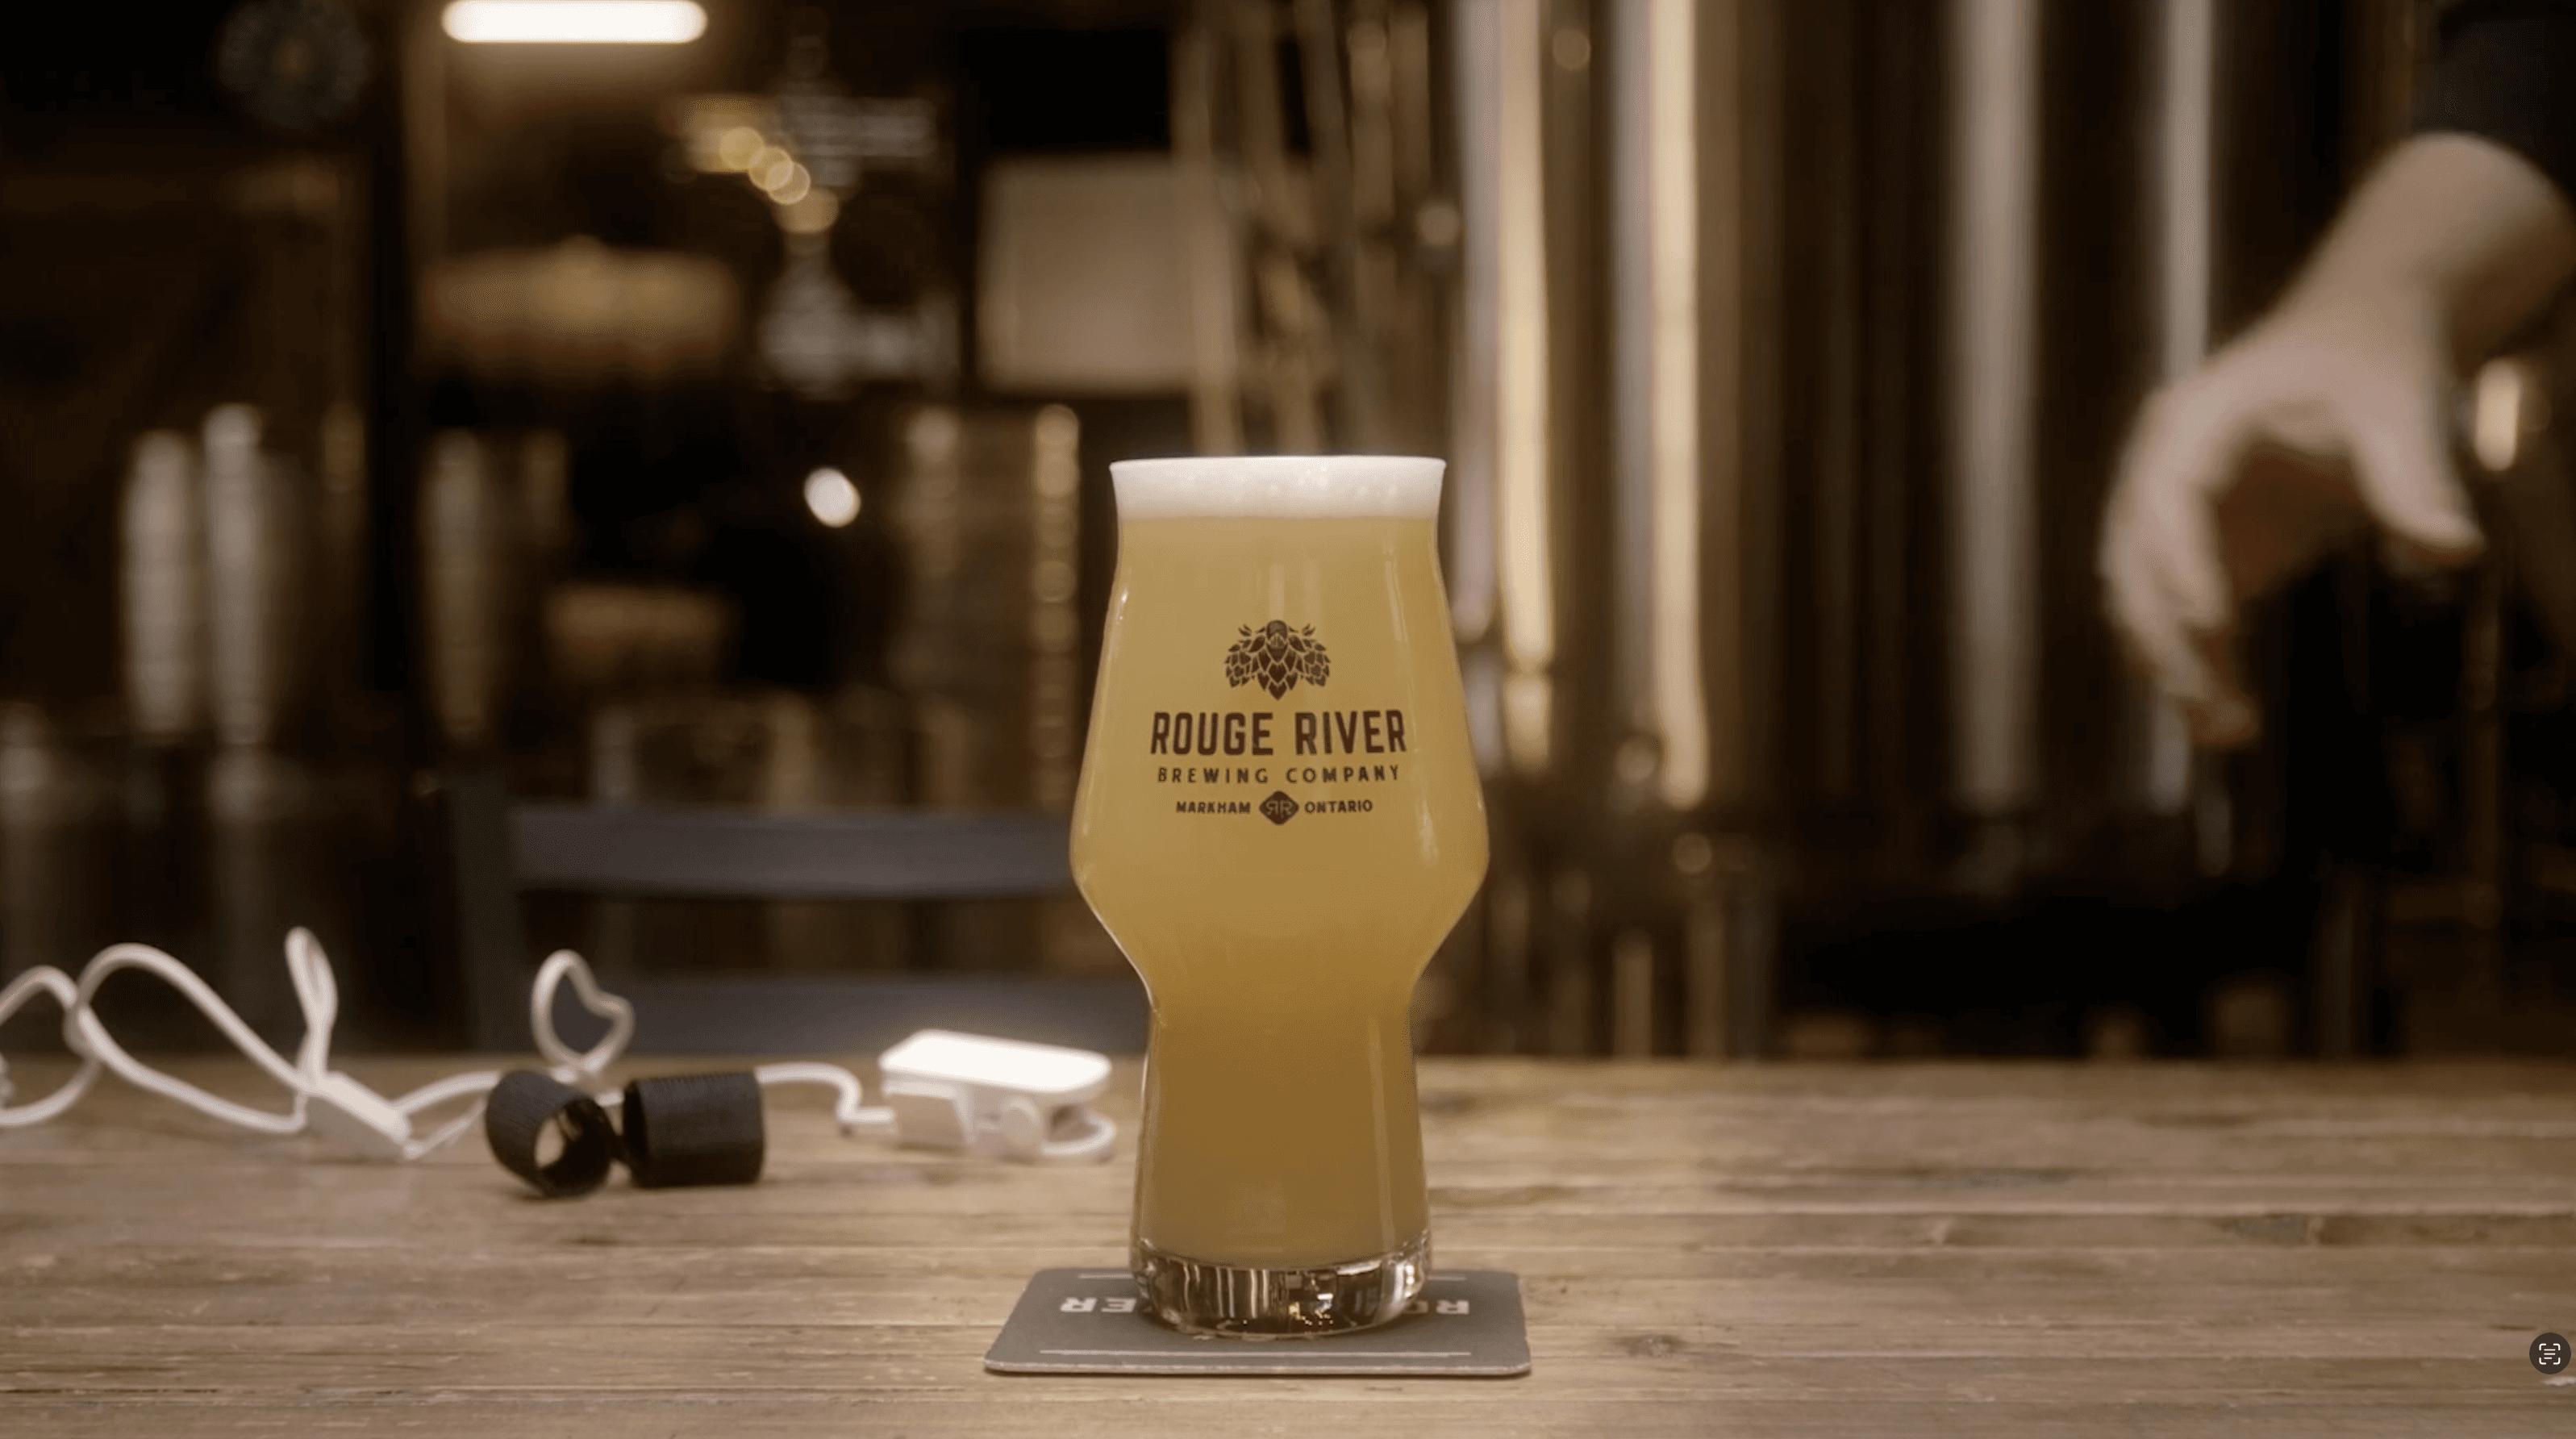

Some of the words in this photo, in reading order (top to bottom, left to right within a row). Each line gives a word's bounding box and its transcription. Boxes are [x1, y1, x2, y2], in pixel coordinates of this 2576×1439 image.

[1151, 712, 1273, 756] ROUGE
[1294, 709, 1407, 756] RIVER
[1157, 767, 1268, 784] BREWING
[1286, 765, 1398, 784] COMPANY
[1176, 801, 1251, 814] MARKHAM
[1305, 800, 1372, 813] ONTARIO
